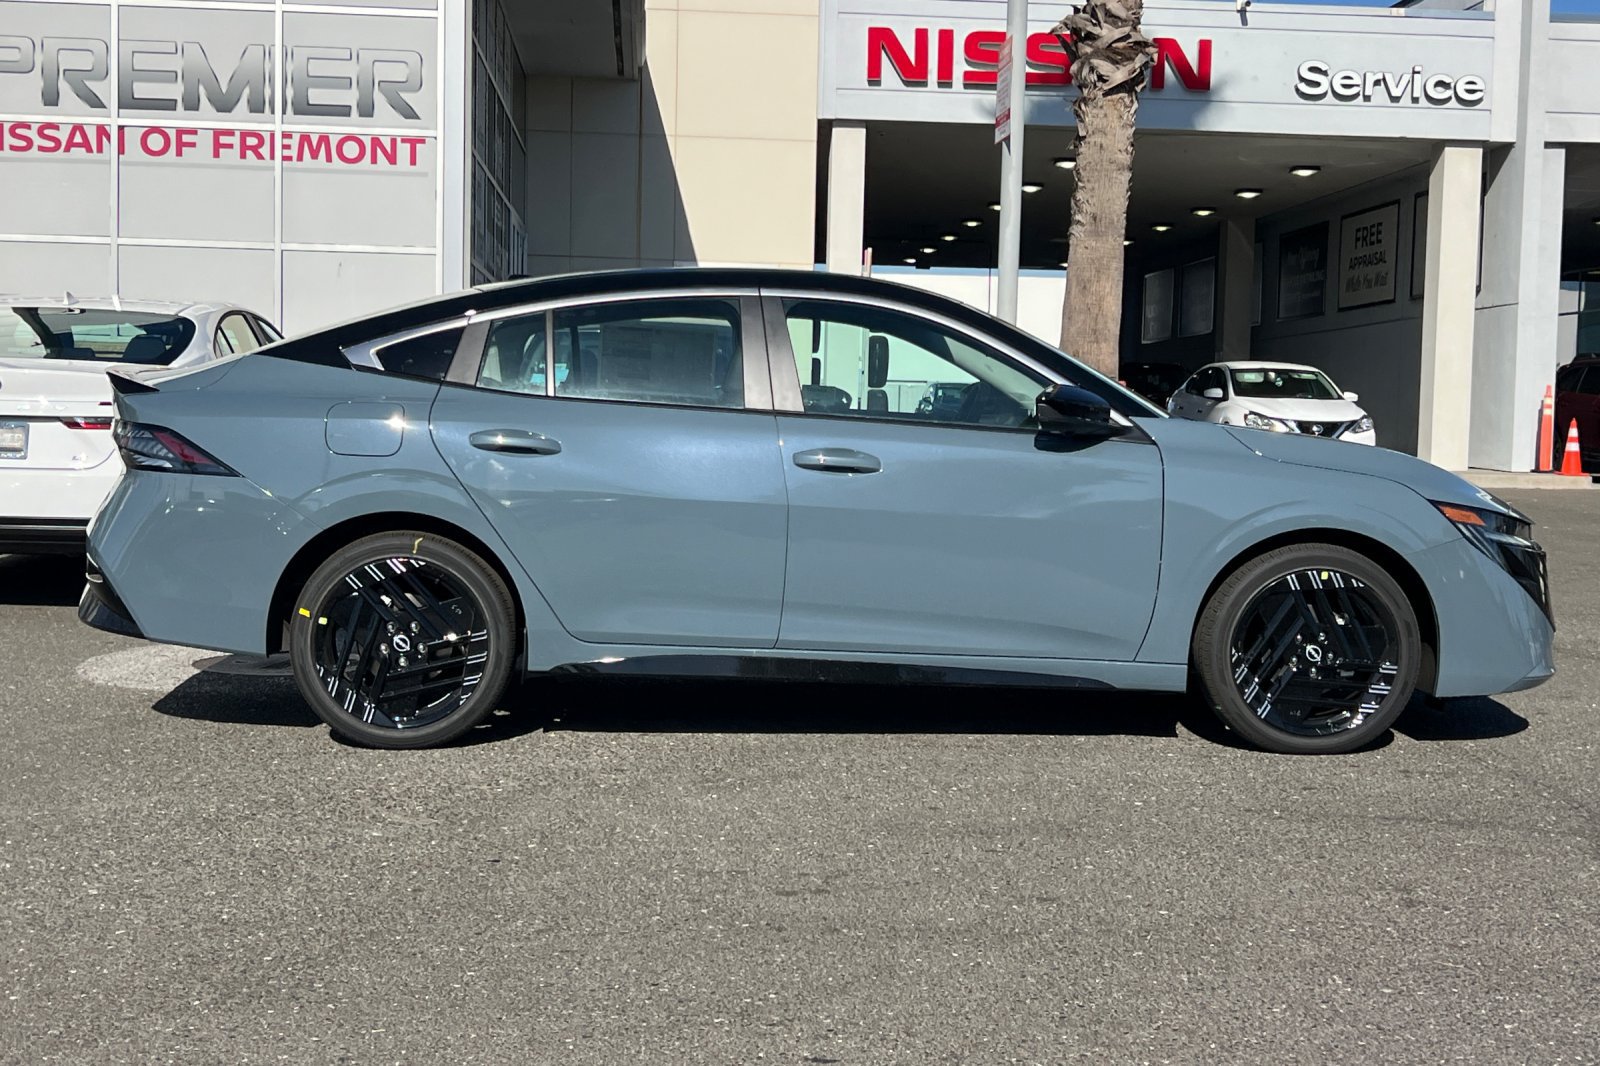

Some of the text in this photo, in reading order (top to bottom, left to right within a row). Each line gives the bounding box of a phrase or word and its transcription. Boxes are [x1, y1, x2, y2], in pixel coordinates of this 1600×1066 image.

[866, 26, 1212, 90] NISSN
[1296, 59, 1487, 106] Service
[140, 127, 197, 158] OF
[212, 129, 426, 166] FREMONT
[1354, 222, 1383, 250] FREE
[1348, 249, 1387, 272] APPRAISAL
